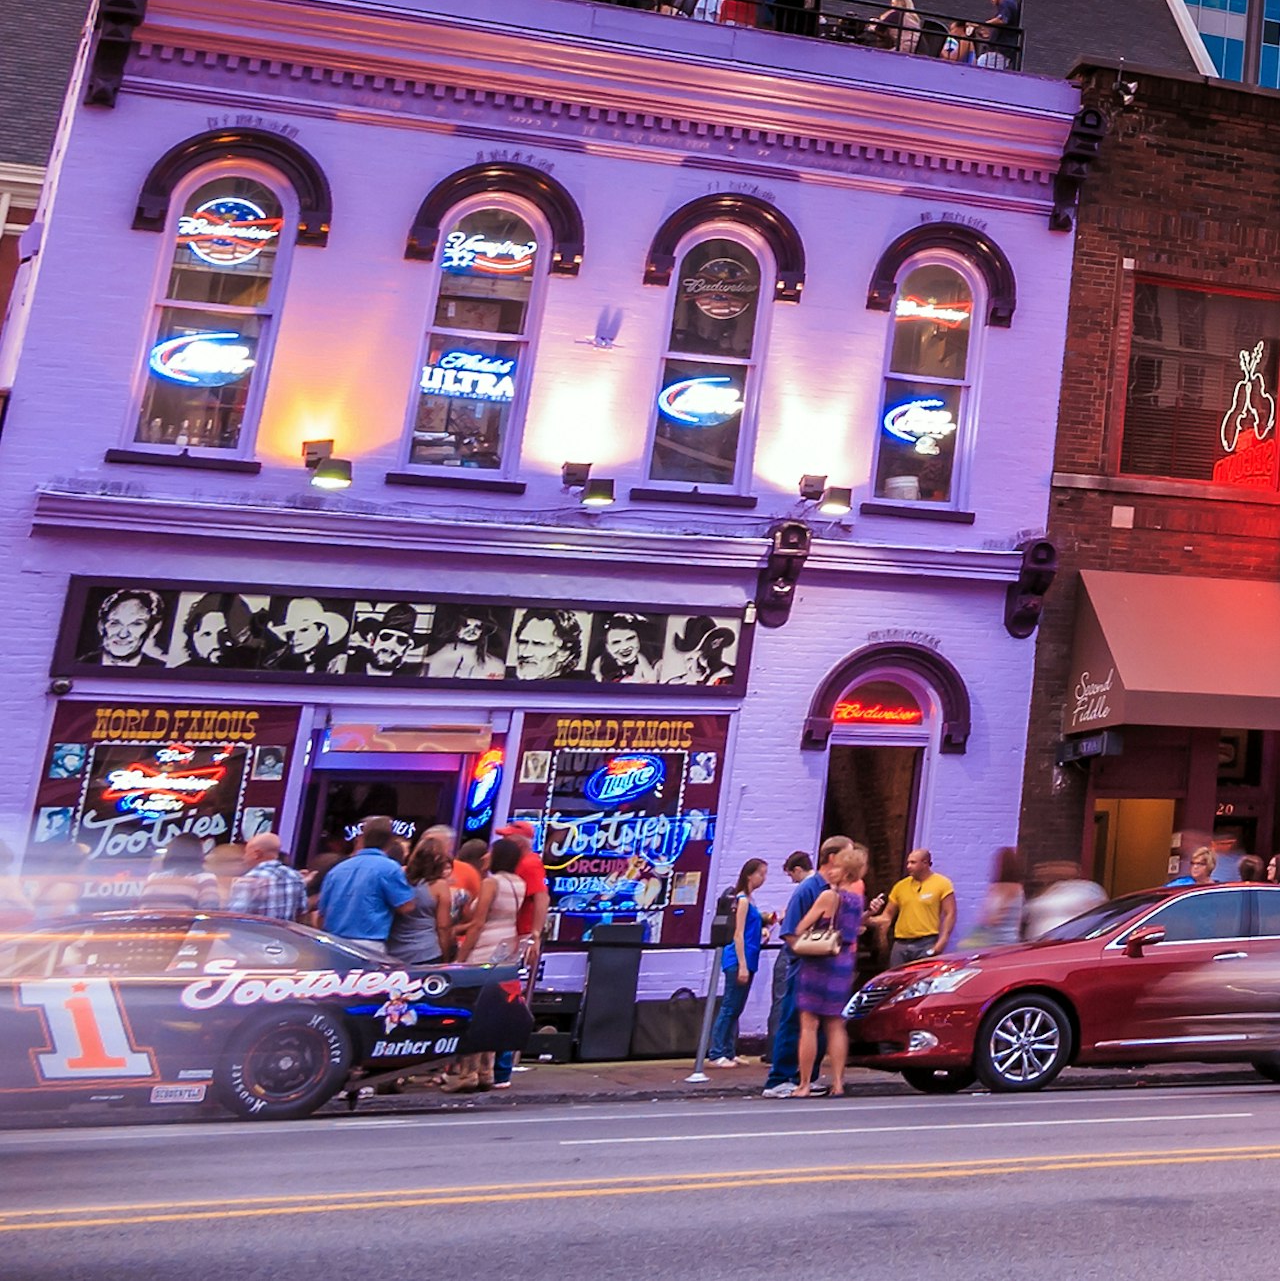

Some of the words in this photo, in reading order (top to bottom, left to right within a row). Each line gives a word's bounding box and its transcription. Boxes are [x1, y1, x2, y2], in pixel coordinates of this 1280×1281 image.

[419, 366, 515, 398] ULTRA
[1074, 668, 1114, 700] Second
[91, 708, 169, 739] WORLD
[170, 709, 259, 740] FAMOUS
[835, 703, 917, 720] Budweiser
[1072, 695, 1111, 726] Fiddle
[554, 719, 619, 747] WORLD
[619, 720, 694, 748] FAMOUS
[83, 808, 228, 861] Tootsies
[344, 821, 364, 842] JAC
[83, 881, 145, 898] LOUN
[180, 959, 426, 1009] Tootsies
[307, 1013, 341, 1065] Hoosier
[371, 1039, 431, 1059] Barber
